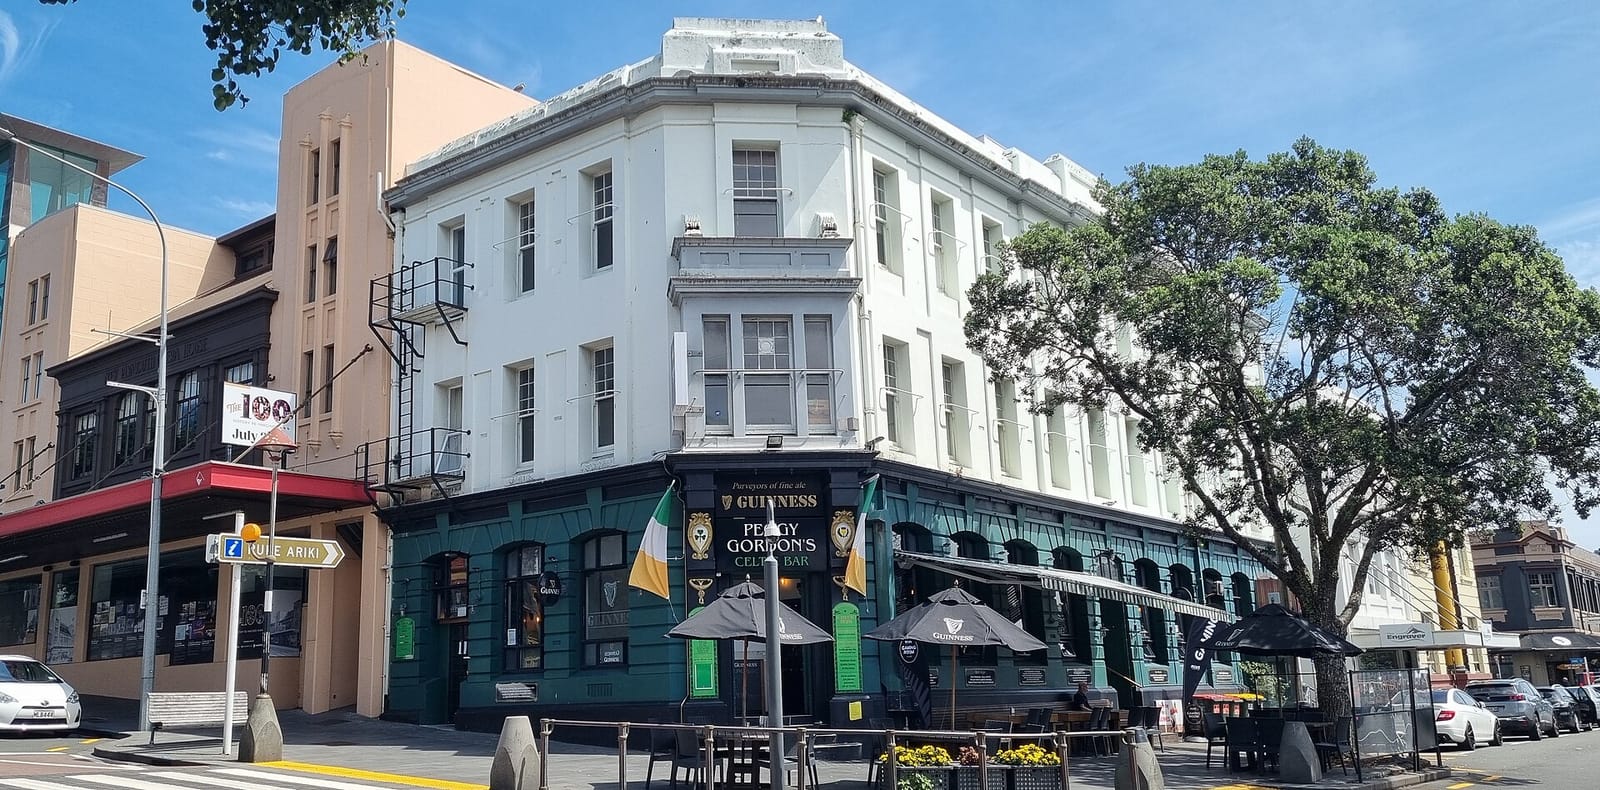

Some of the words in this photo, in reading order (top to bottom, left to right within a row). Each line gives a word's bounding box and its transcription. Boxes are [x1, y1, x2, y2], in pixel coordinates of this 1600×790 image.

[240, 393, 291, 423] 100
[232, 429, 257, 444] July
[732, 482, 768, 491] Purveyors
[286, 546, 319, 559] ARIKI
[735, 556, 778, 567] CELT
[784, 556, 809, 566] BAR
[933, 632, 974, 642] GUINNESS
[1387, 632, 1426, 642] Engraver
